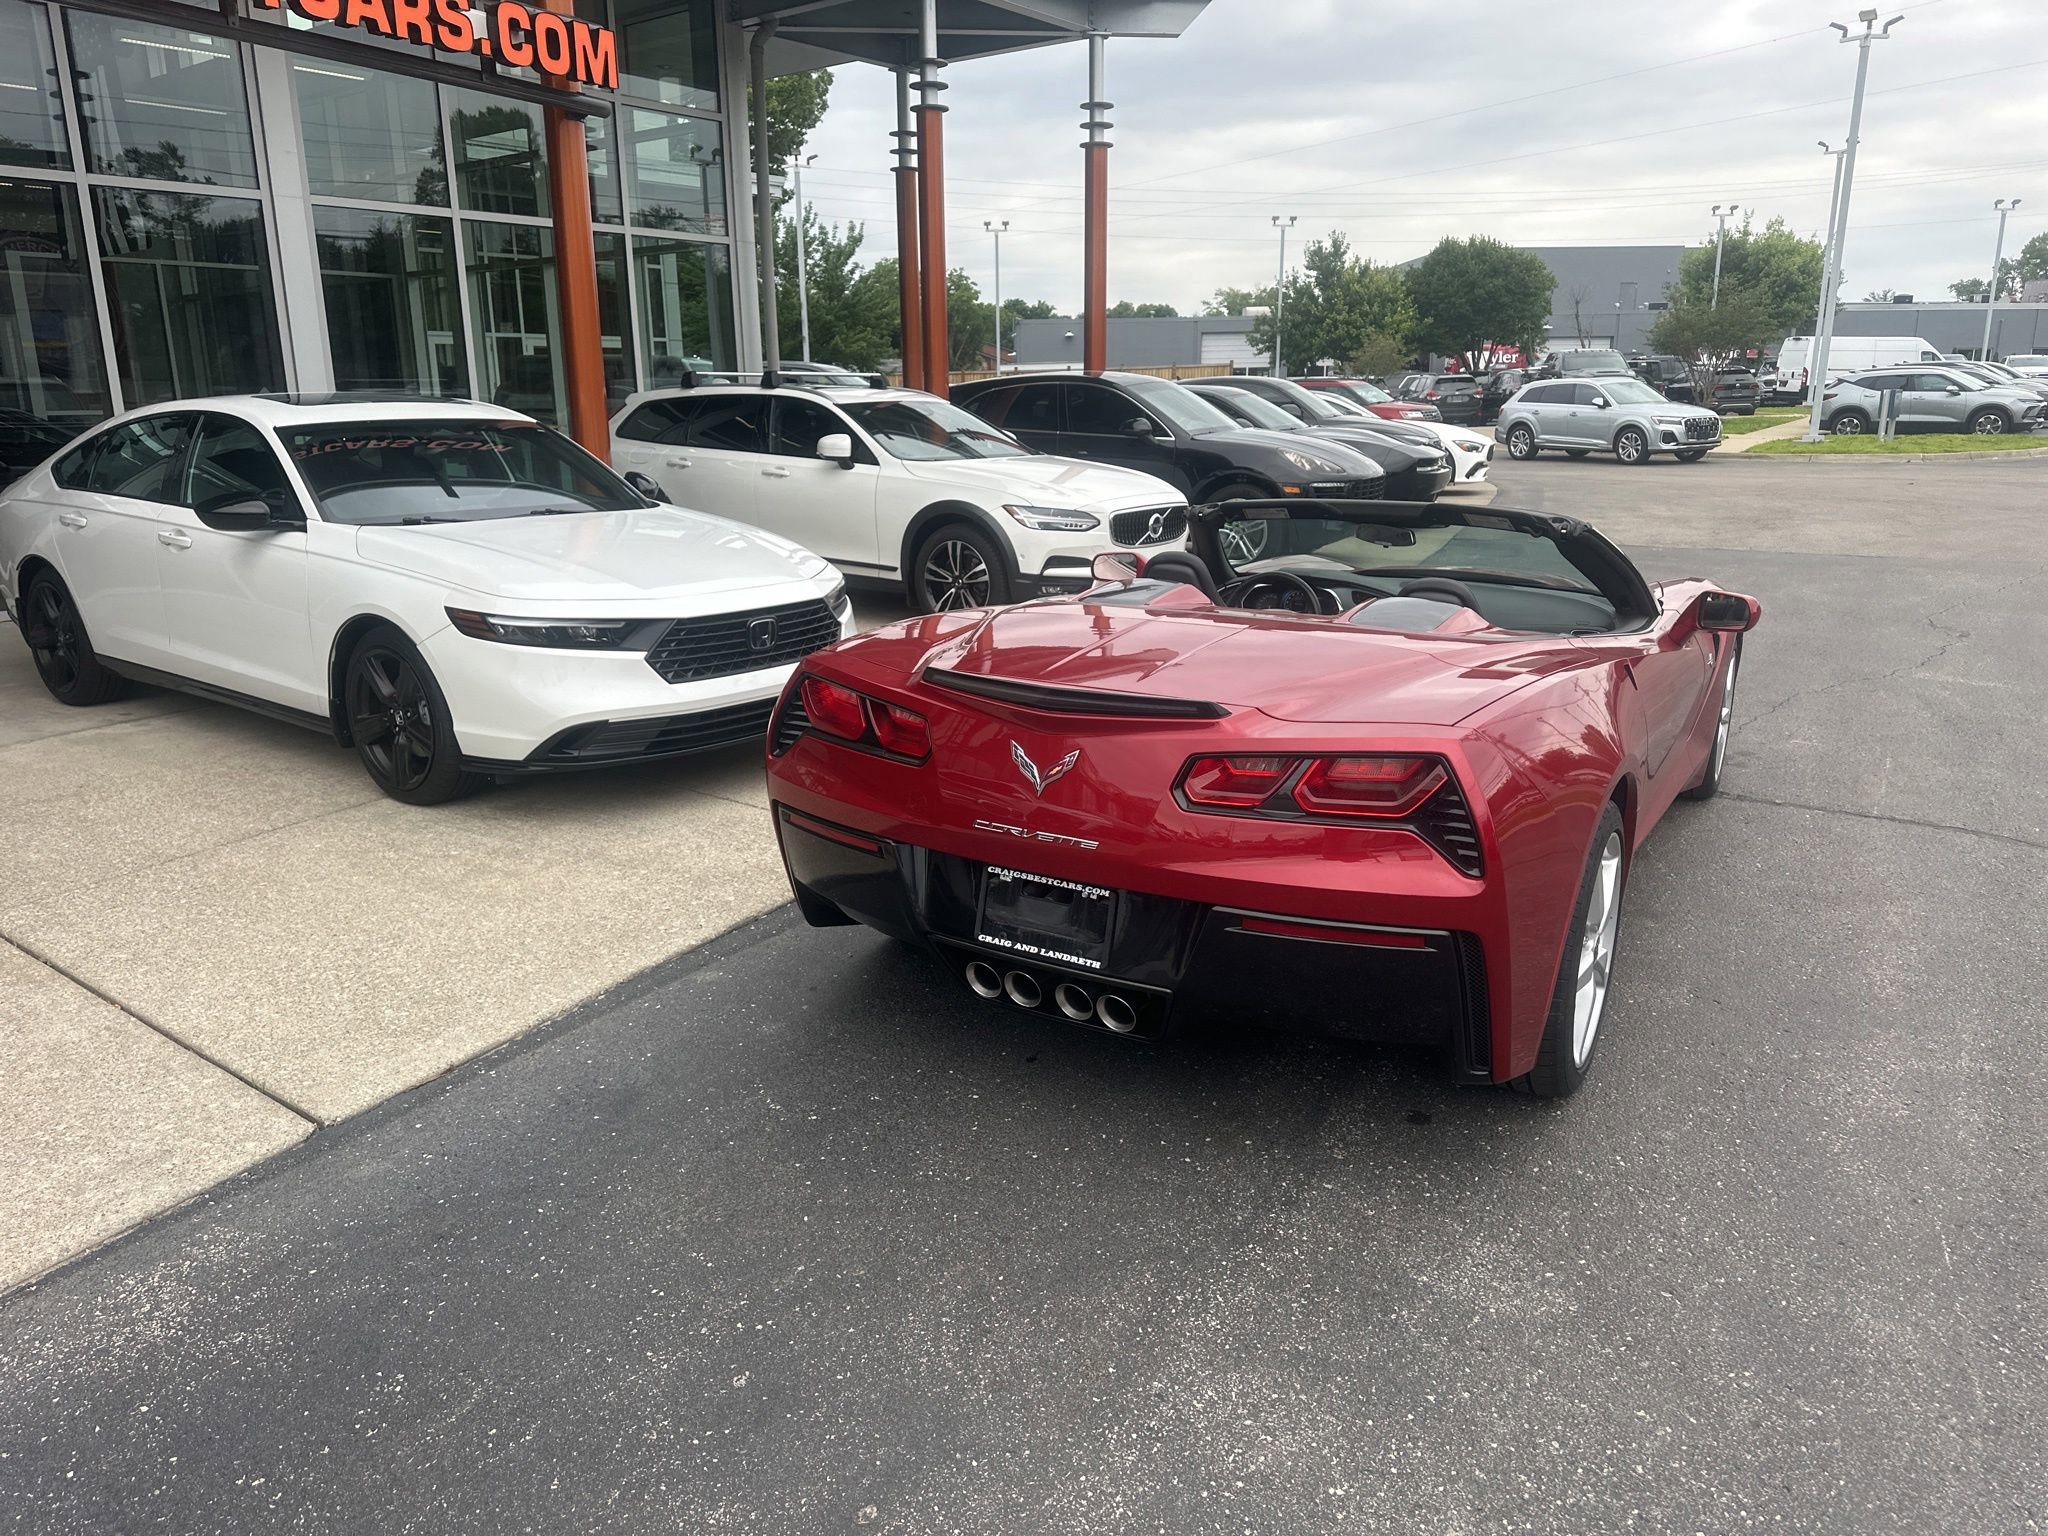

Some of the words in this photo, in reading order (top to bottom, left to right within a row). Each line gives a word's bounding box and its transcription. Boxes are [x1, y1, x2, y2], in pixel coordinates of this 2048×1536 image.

[264, 0, 619, 89] ARS.COM
[973, 819, 1100, 850] CORVETTE
[987, 865, 1111, 898] CRAIGSBESTCARS.COM
[977, 933, 1013, 948] CRAIG
[1013, 942, 1039, 955] AND
[1039, 948, 1102, 969] LANDRETH
